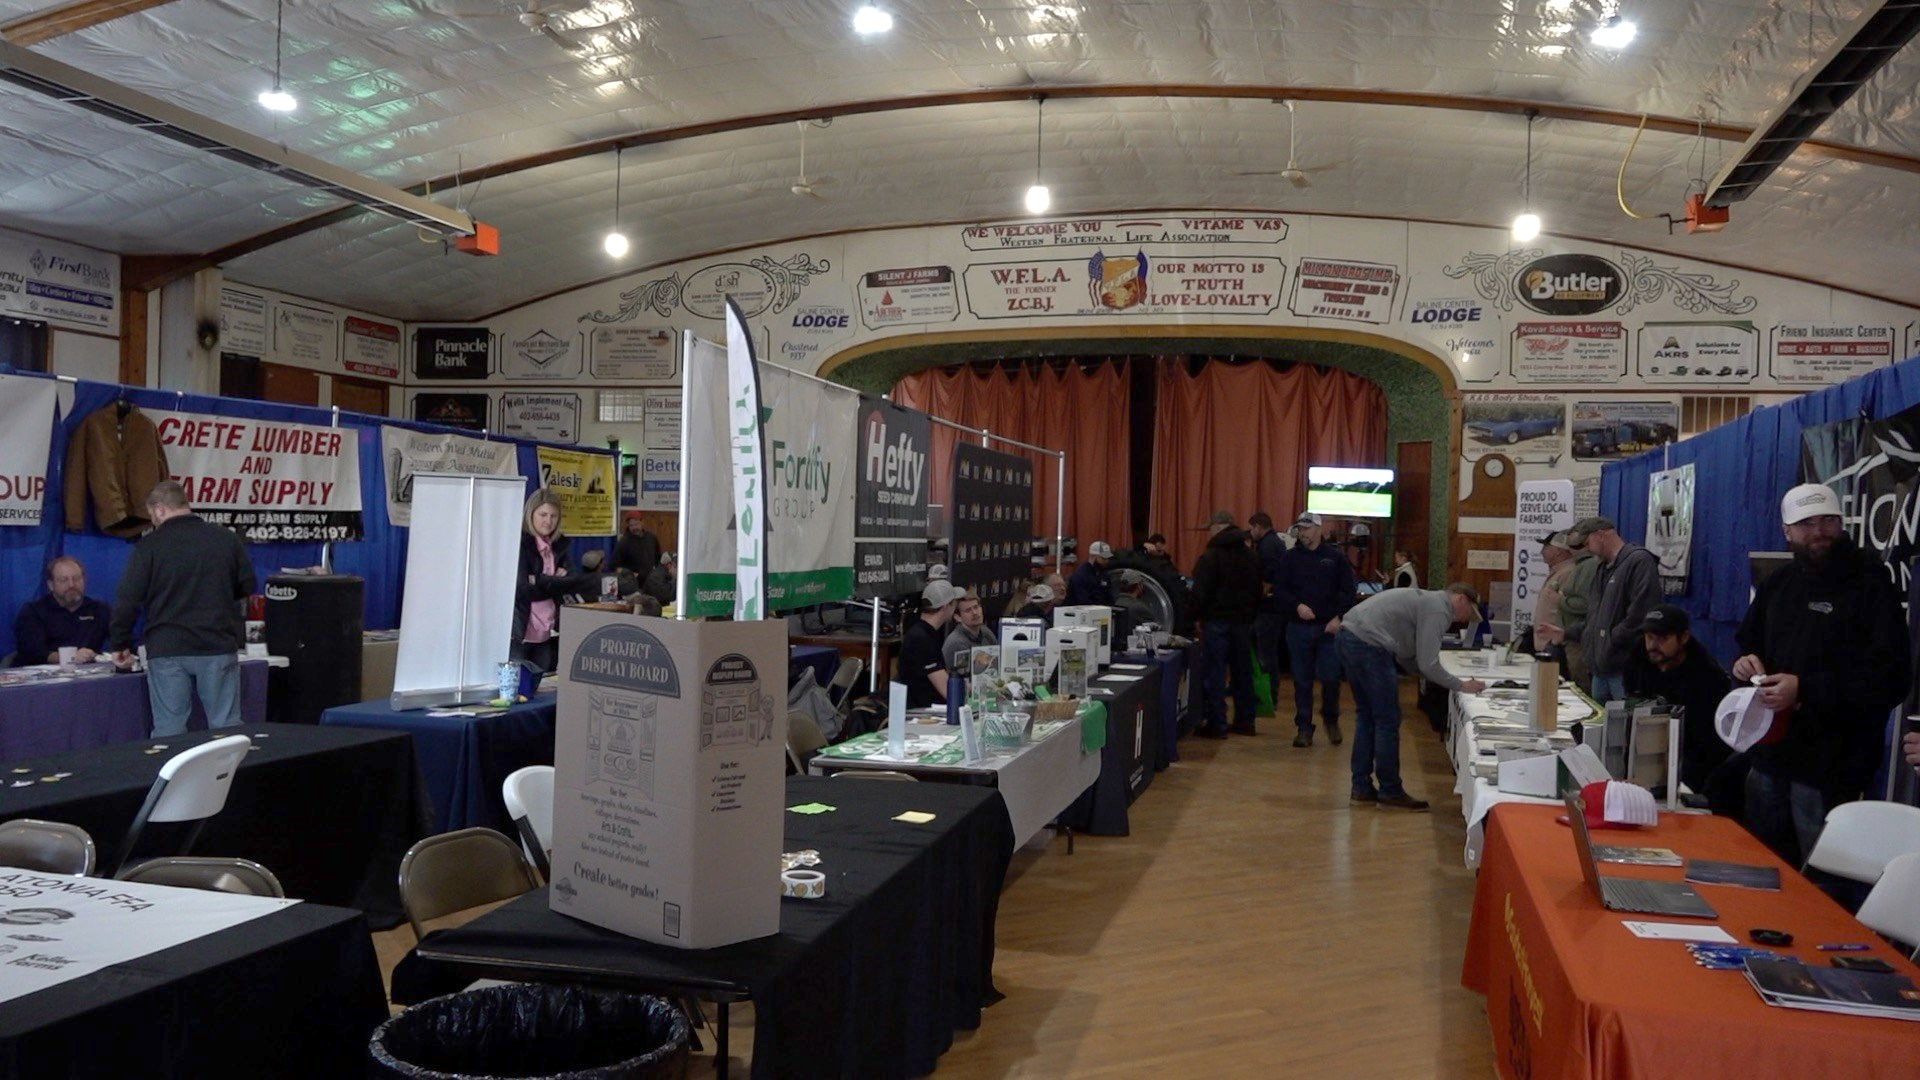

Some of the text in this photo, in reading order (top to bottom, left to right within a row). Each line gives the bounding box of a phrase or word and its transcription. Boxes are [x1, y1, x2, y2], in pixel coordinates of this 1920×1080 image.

[967, 219, 1281, 239] WE WELCOME YOU VITAME VAS
[913, 269, 940, 279] FARMS
[1157, 263, 1265, 274] OUR MOTTO IS
[1005, 287, 1019, 295] THE
[1181, 278, 1244, 291] TRUTH
[1530, 270, 1615, 299] Butler
[792, 315, 850, 328] LODGE
[1411, 307, 1482, 324] LODGE
[1549, 325, 1573, 334] Sales
[1585, 324, 1619, 333] Service
[1780, 325, 1887, 338] FRIEND INSURANCE CENTER
[435, 337, 488, 353] Pinnacle
[434, 353, 467, 367] Bank
[1654, 350, 1689, 359] AKRS
[158, 417, 342, 458] CRETE LUMBER
[239, 456, 273, 475] AND
[866, 420, 926, 507] Hefty
[772, 440, 831, 505] Fortify
[248, 478, 334, 506] SUPPLY
[1520, 491, 1557, 502] PROUD TO
[773, 497, 816, 519] GROUP
[1520, 502, 1568, 513] SERVE LOCAL
[199, 512, 328, 525] WARE AND FARM SUPPLY
[1519, 514, 1553, 524] FARMERS
[600, 638, 651, 660] PROJECT
[581, 655, 669, 683] DISPLAY BOARD
[574, 861, 659, 901] Create better grades!
[98, 893, 155, 913] FFA
